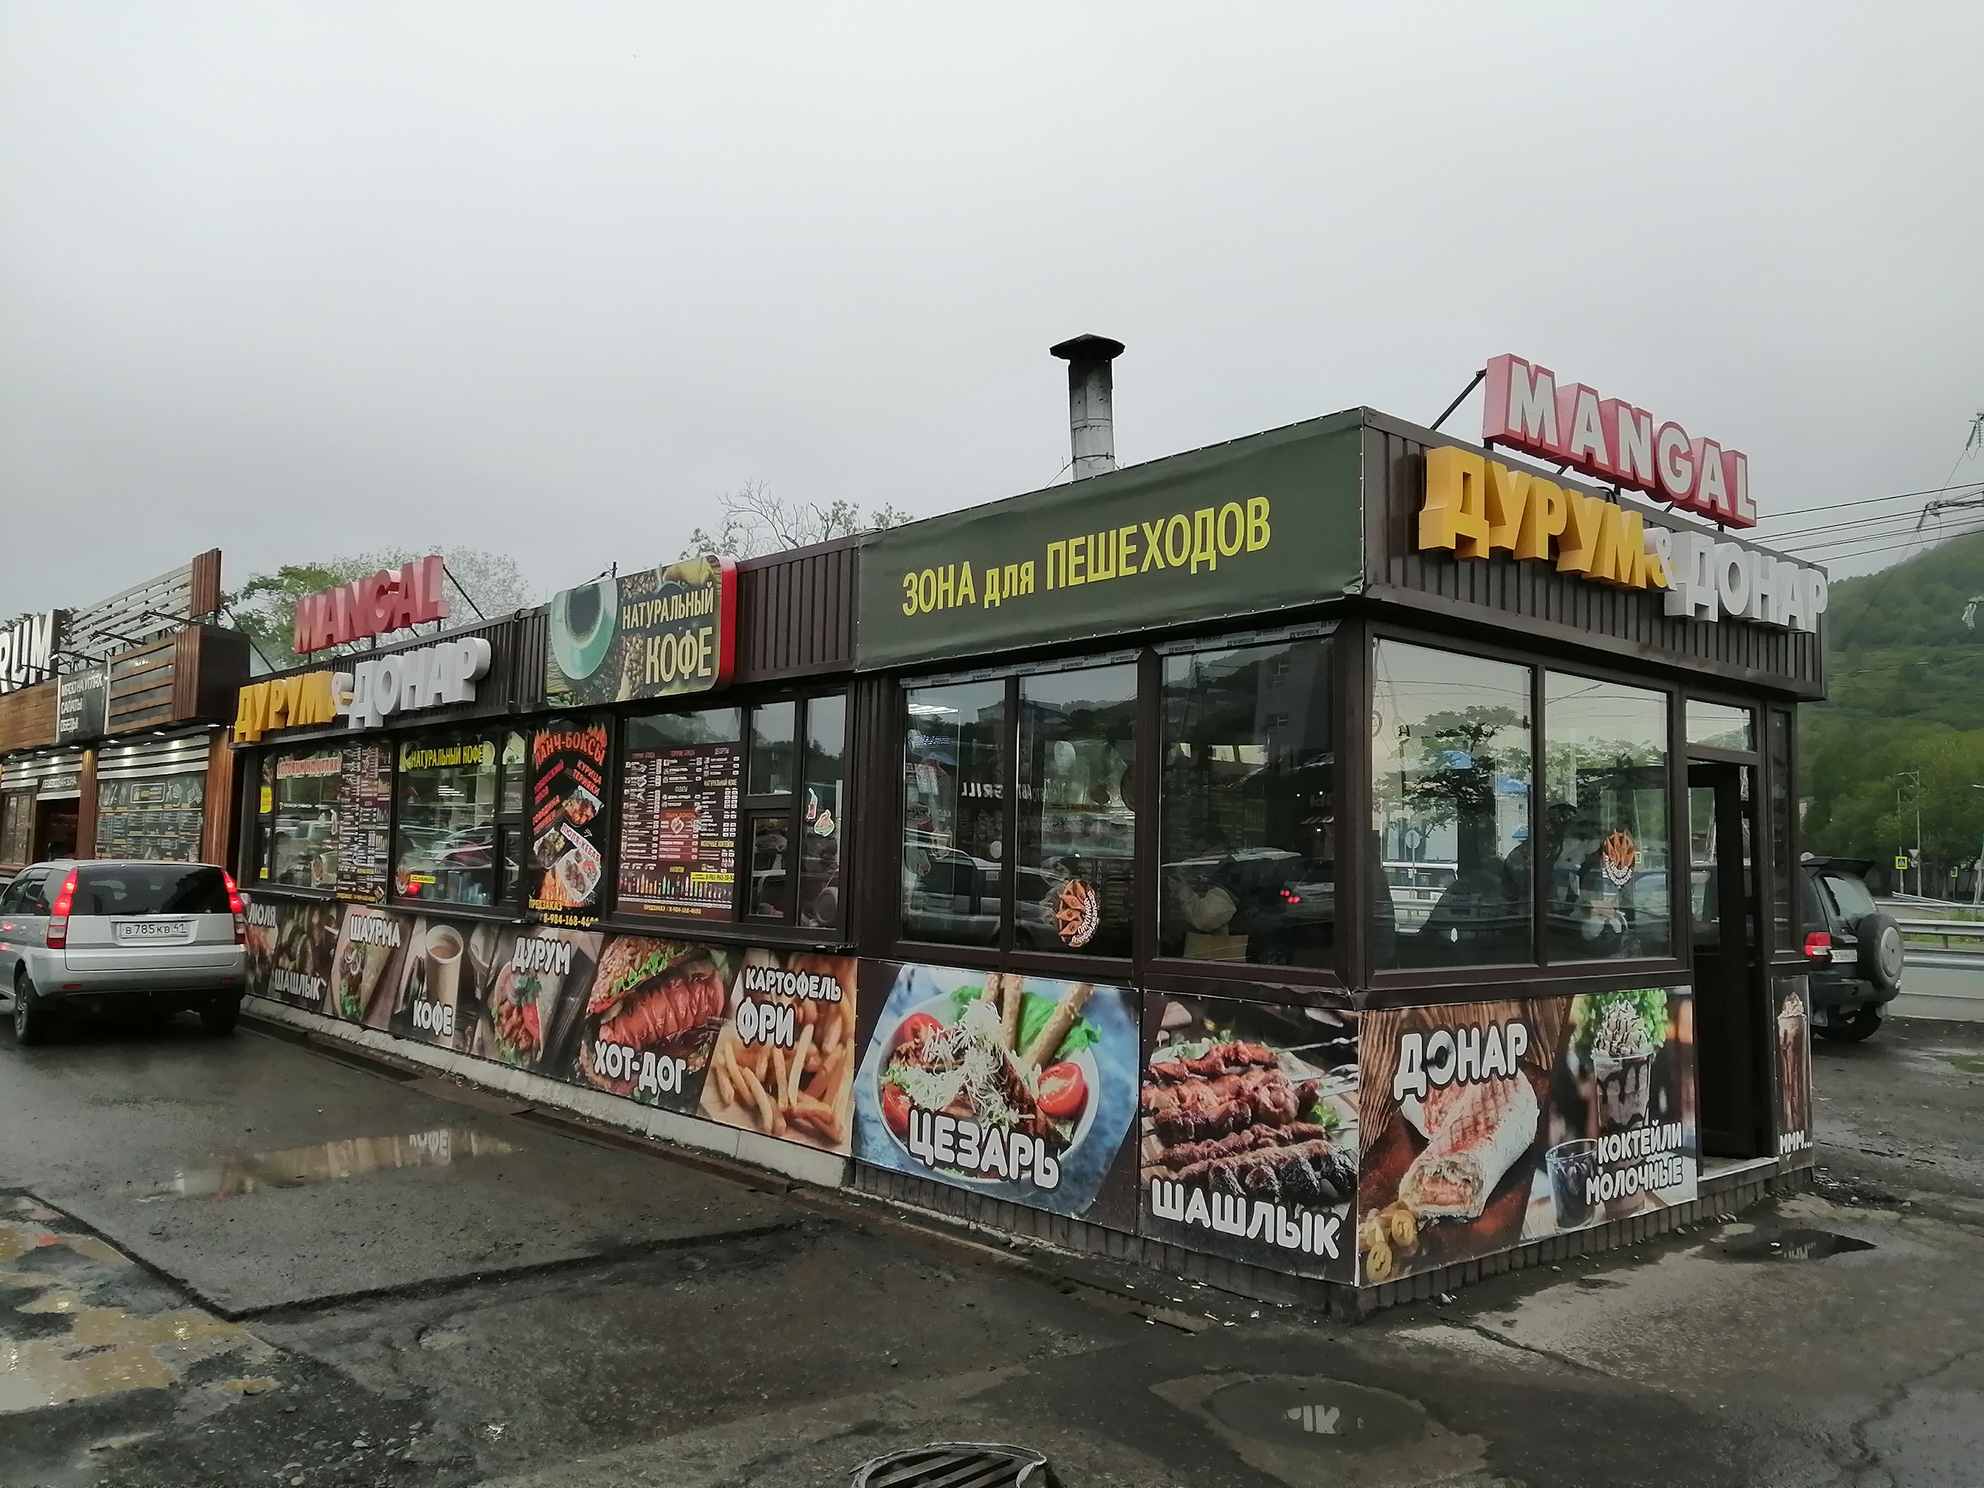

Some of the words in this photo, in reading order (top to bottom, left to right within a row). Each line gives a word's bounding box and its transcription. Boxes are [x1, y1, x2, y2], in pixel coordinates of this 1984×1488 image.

[1483, 353, 1756, 528] MANGAL
[902, 561, 977, 617] ЗОНА
[984, 560, 1035, 609] для
[1047, 496, 1271, 589] ПЕШЕХОДОВ
[1419, 446, 1646, 589] ДУРУМ
[1664, 530, 1828, 633] ДОНАР
[293, 555, 449, 654] MANGAL
[622, 581, 714, 630] НАТУРАЛЬНЫЙ
[645, 626, 713, 684] КОФЕ
[235, 671, 335, 742] ДУРУМ
[349, 637, 491, 730] ДОНАР
[411, 743, 462, 769] НАТУРАЛЬНЫЙ
[462, 744, 483, 765] КОФЕ
[351, 914, 400, 947] ШАУРМА
[511, 937, 571, 975] ДУРУМ
[275, 969, 321, 1000] ШАШЛЫК
[746, 967, 843, 1002] КАРТОФЕЛЬ
[413, 1000, 453, 1036] КОФЕ
[737, 999, 796, 1047] ФРИ
[595, 1040, 686, 1095] ХОТ-ДОГ
[1394, 1023, 1528, 1100] ДОНАР
[909, 1110, 1060, 1189] ЦЕЗАРЬ
[1598, 1120, 1682, 1164] КОКТЕЙЛИ
[1585, 1156, 1684, 1205] МОЛОЧНЫЕ
[1152, 1178, 1340, 1260] ШАШЛЫК
